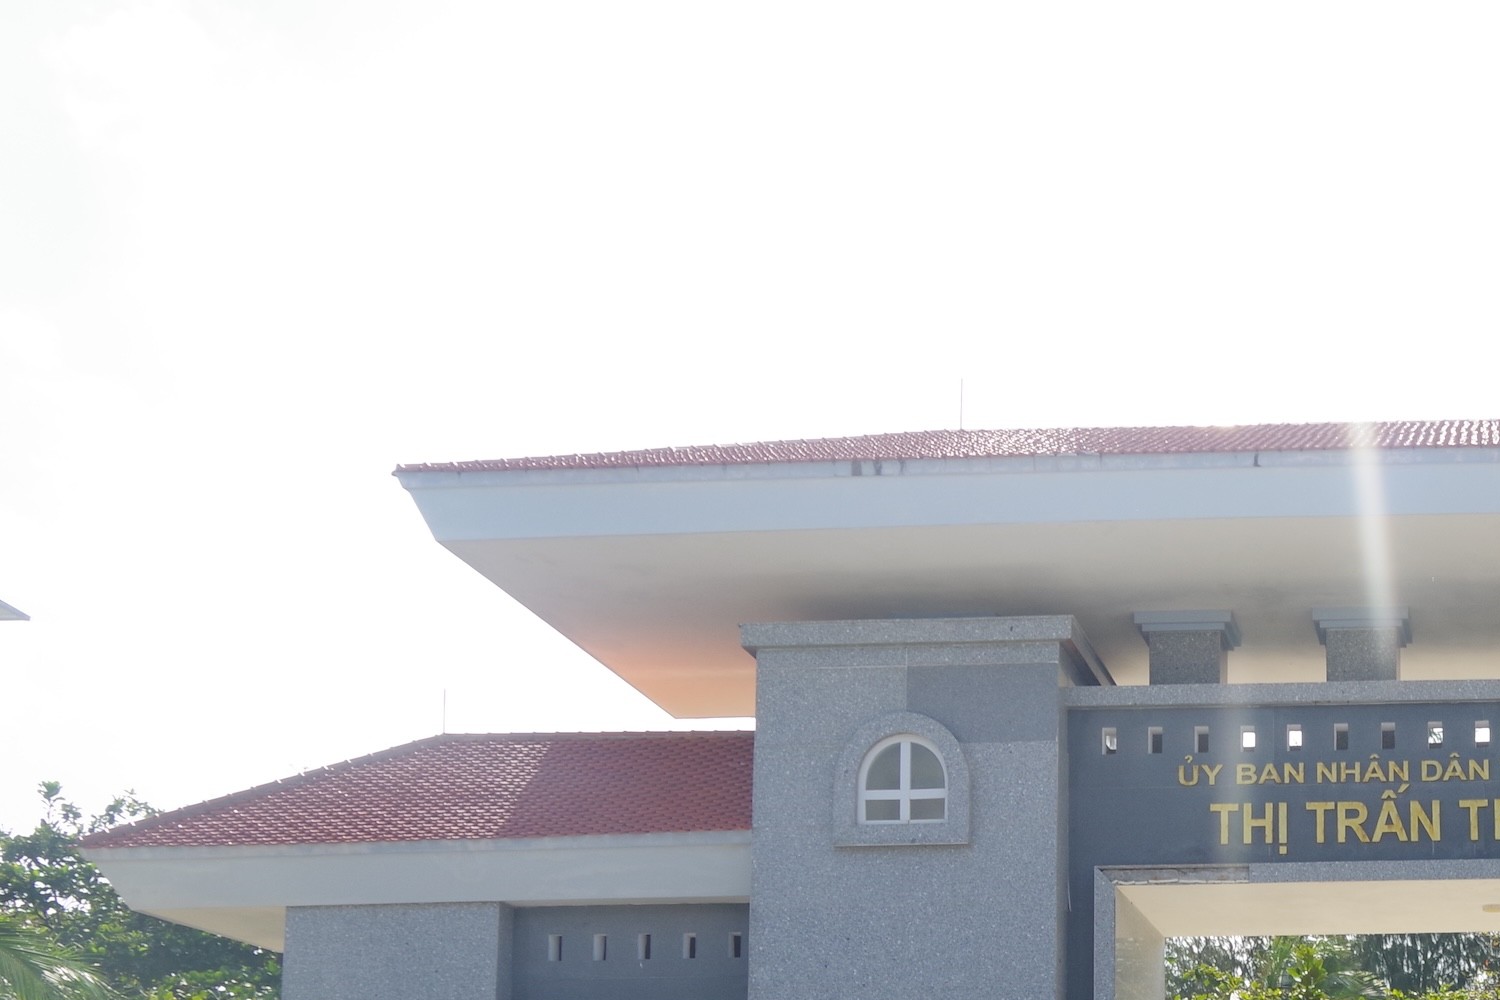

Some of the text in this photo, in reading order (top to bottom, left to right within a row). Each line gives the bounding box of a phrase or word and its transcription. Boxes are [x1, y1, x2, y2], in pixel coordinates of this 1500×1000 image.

[1178, 755, 1223, 786] ỦY
[1236, 763, 1305, 785] BAN
[1316, 754, 1409, 783] NHÂN
[1421, 753, 1490, 782] DÂN
[1210, 802, 1288, 854] THỊ
[1306, 784, 1441, 843] TRẤN
